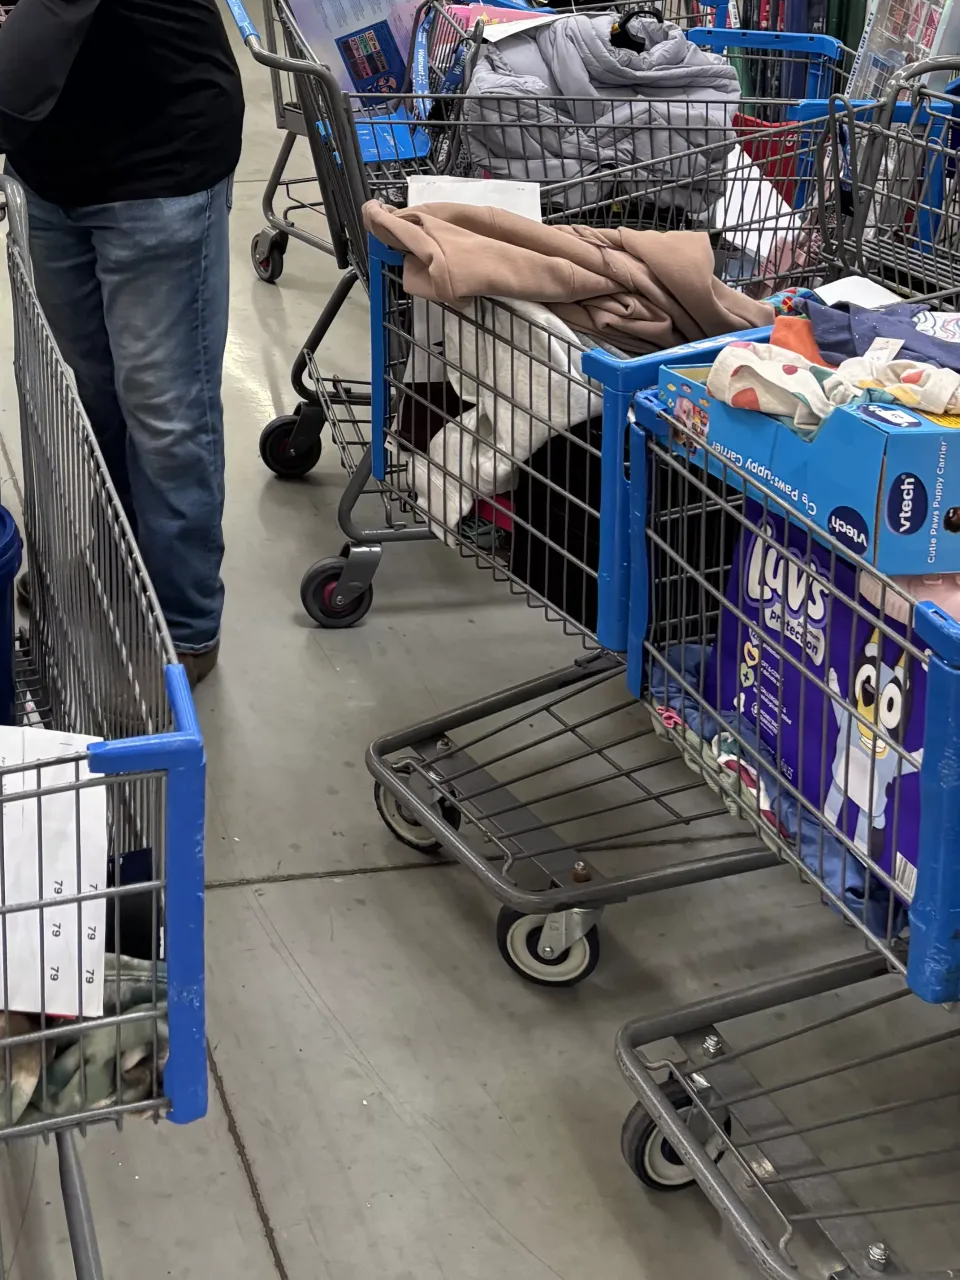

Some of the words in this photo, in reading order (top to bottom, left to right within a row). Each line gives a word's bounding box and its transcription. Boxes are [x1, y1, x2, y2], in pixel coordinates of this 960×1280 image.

[860, 32, 868, 50] GIFT
[867, 12, 875, 30] SET
[936, 441, 947, 475] Carrier
[898, 477, 915, 533] vtech
[932, 477, 945, 508] Puppy
[831, 516, 868, 548] vtech
[929, 510, 940, 535] Paws
[927, 538, 937, 564] Cutie
[53, 880, 63, 894] 79
[51, 922, 61, 938] 79
[87, 925, 96, 941] 79
[50, 966, 59, 981] 79
[85, 968, 95, 984] 79
